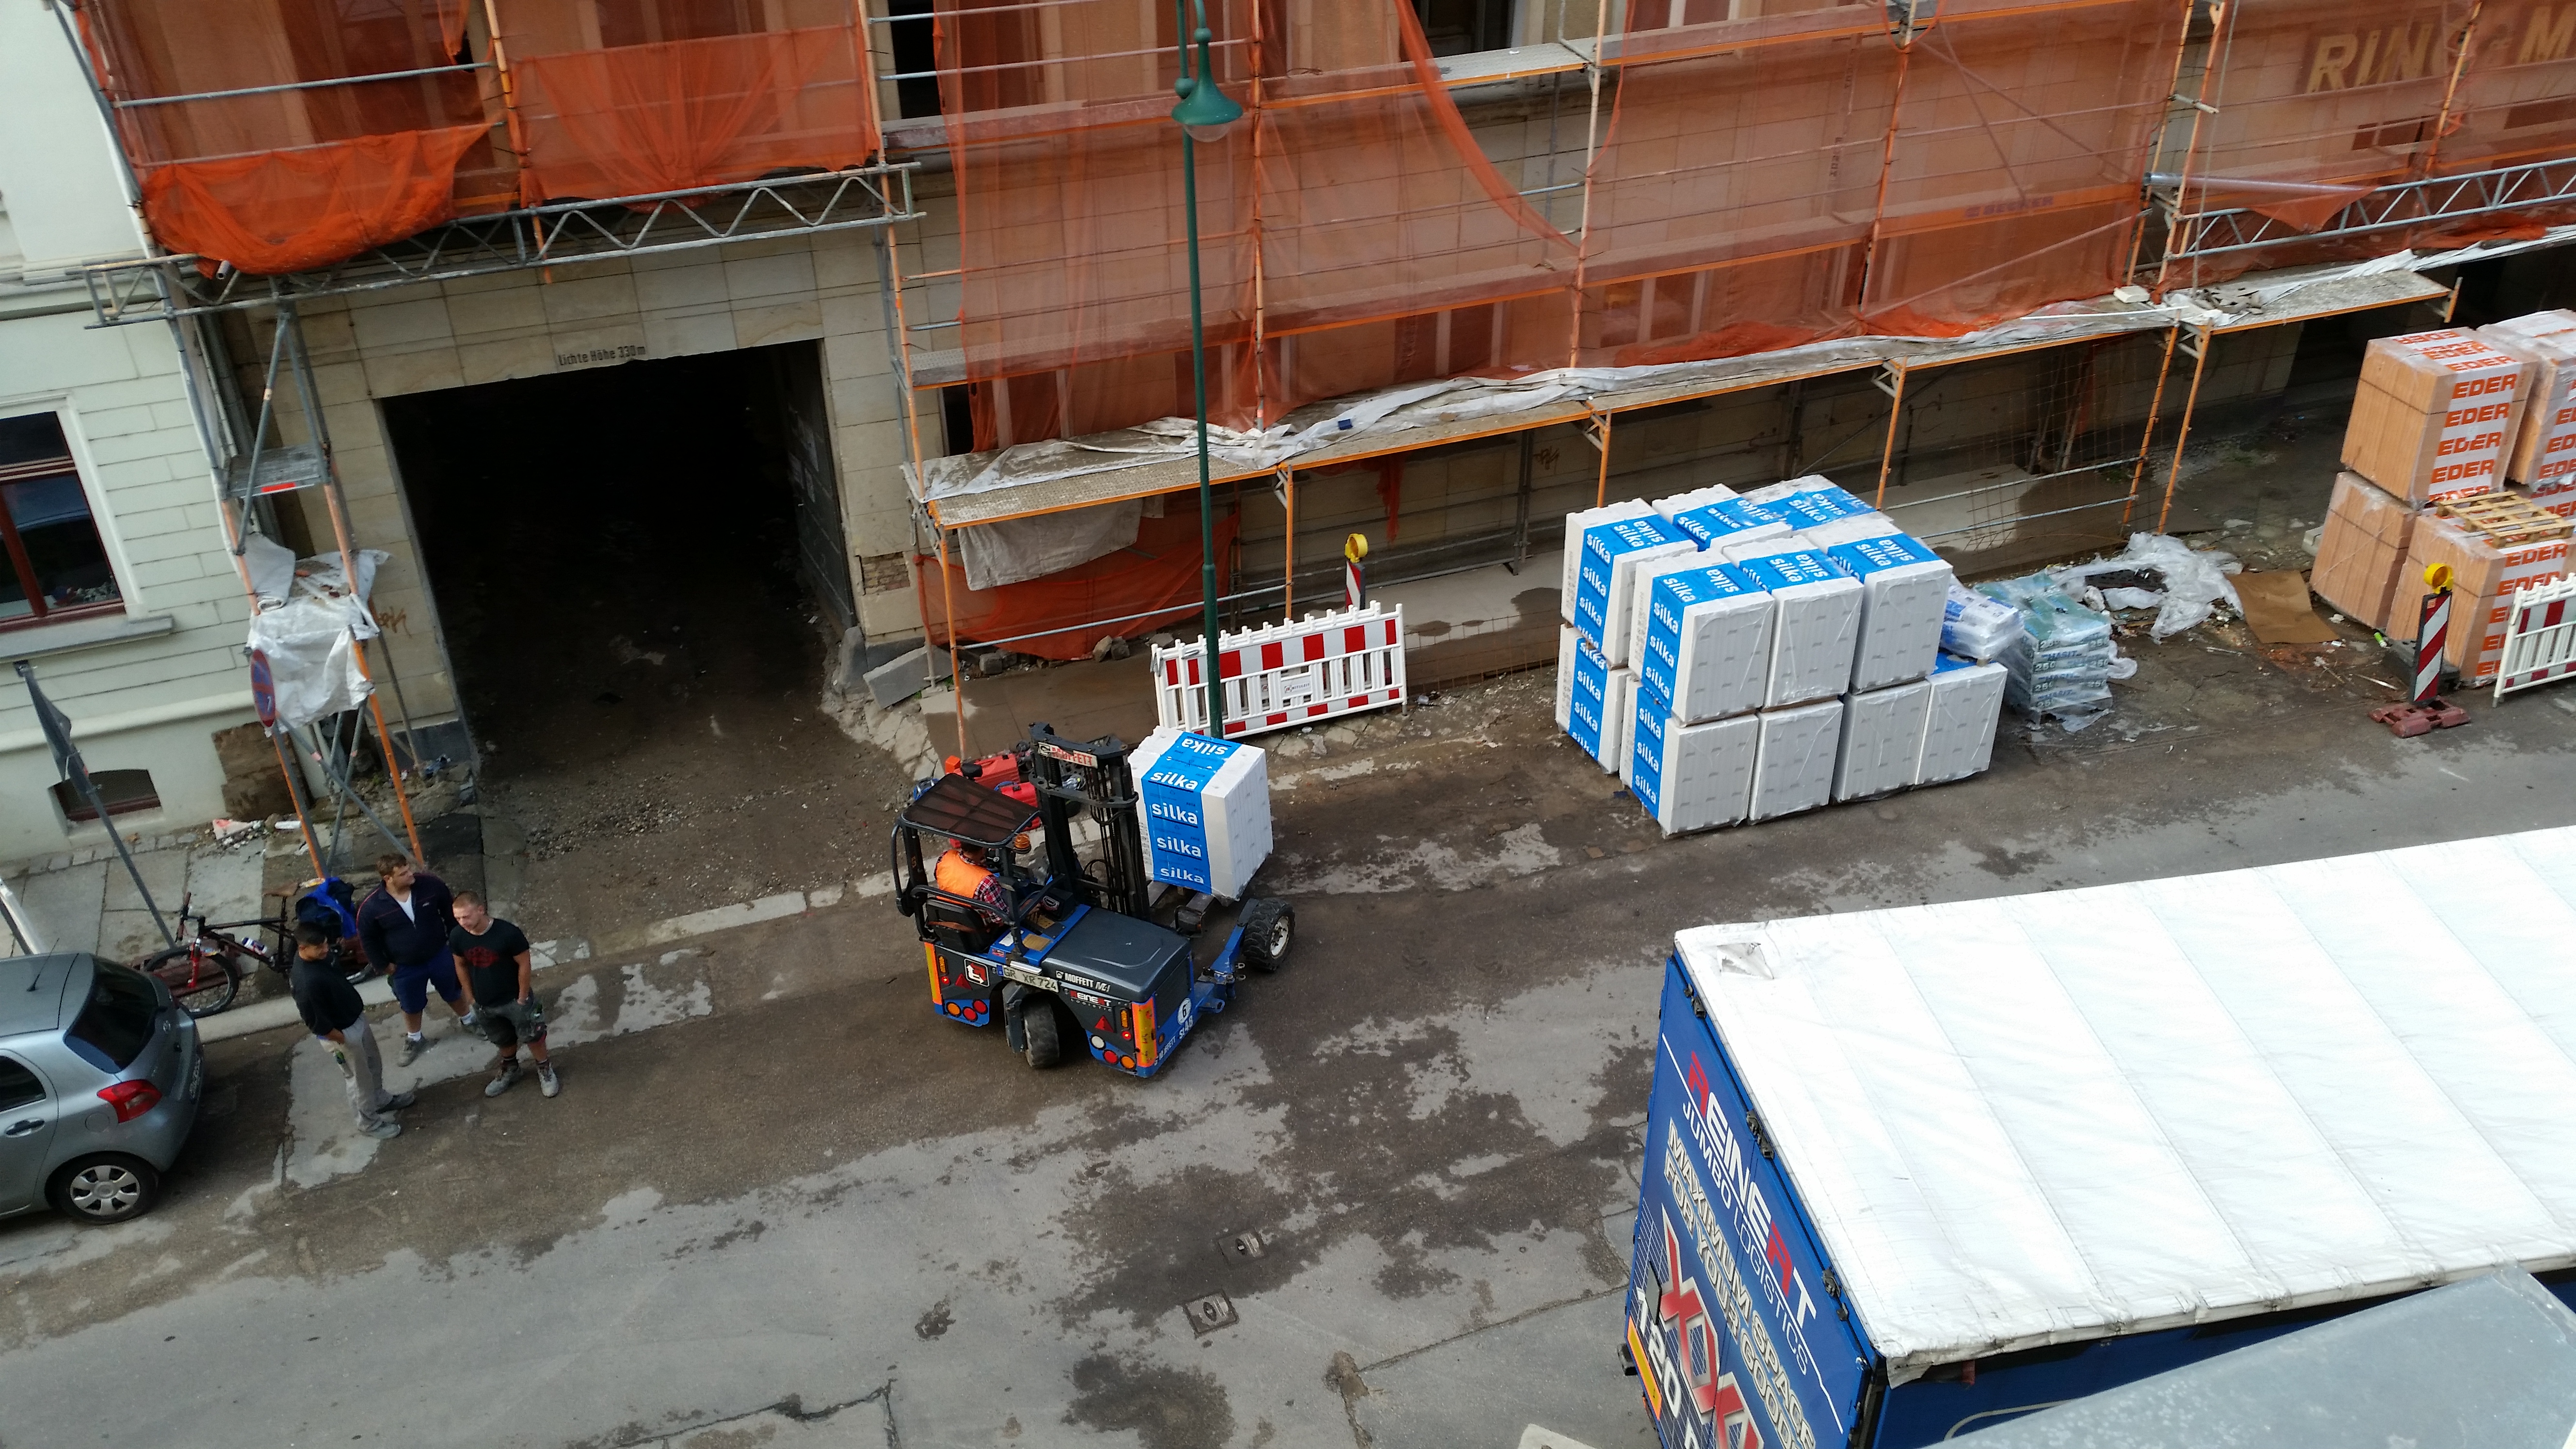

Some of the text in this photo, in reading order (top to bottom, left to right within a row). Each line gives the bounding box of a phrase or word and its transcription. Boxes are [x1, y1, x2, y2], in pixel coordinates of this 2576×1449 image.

[2445, 355, 2518, 371] EDER
[2452, 373, 2517, 399] EDER
[2444, 402, 2510, 428] EDER
[2437, 432, 2502, 456] EDER
[2431, 459, 2495, 484] EDER
[1788, 499, 1827, 522] silka
[1812, 493, 1848, 515] silka
[1613, 524, 1644, 548] silka
[1633, 520, 1665, 543] silka
[1677, 515, 1711, 541] silka
[1586, 533, 1611, 564] silka
[1855, 543, 1891, 567] silka
[1878, 539, 1915, 562] silka
[2504, 543, 2569, 568] EDER
[1770, 558, 1803, 582] silka
[1795, 553, 1829, 578] silka
[1582, 566, 1607, 597] silka
[1662, 577, 1696, 603] silka
[1706, 568, 1739, 593] silka
[1579, 596, 1602, 628] silka
[1653, 602, 1679, 635] silka
[1579, 641, 1606, 671] silka
[1649, 635, 1675, 669] silka
[1577, 670, 1601, 702] silka
[1645, 666, 1670, 700] silka
[1574, 701, 1598, 733] silka
[1639, 707, 1661, 740] silka
[1181, 738, 1228, 756] silka
[1637, 741, 1659, 774] silka
[1150, 772, 1198, 790] silka
[1635, 774, 1657, 806] silka
[1151, 802, 1198, 825] silka
[1157, 836, 1202, 858] silka
[1160, 867, 1204, 885] silka
[1004, 968, 1057, 990] GR XR 724
[1064, 972, 1094, 988] MOFFETT
[1182, 1003, 1187, 1018] 6
[1667, 1116, 1753, 1327] MAXIMUM
[1663, 1148, 1696, 1240] FOR
[1695, 1218, 1741, 1345] YOUR
[1682, 1101, 1808, 1376] JUMBO LOGISTICS
